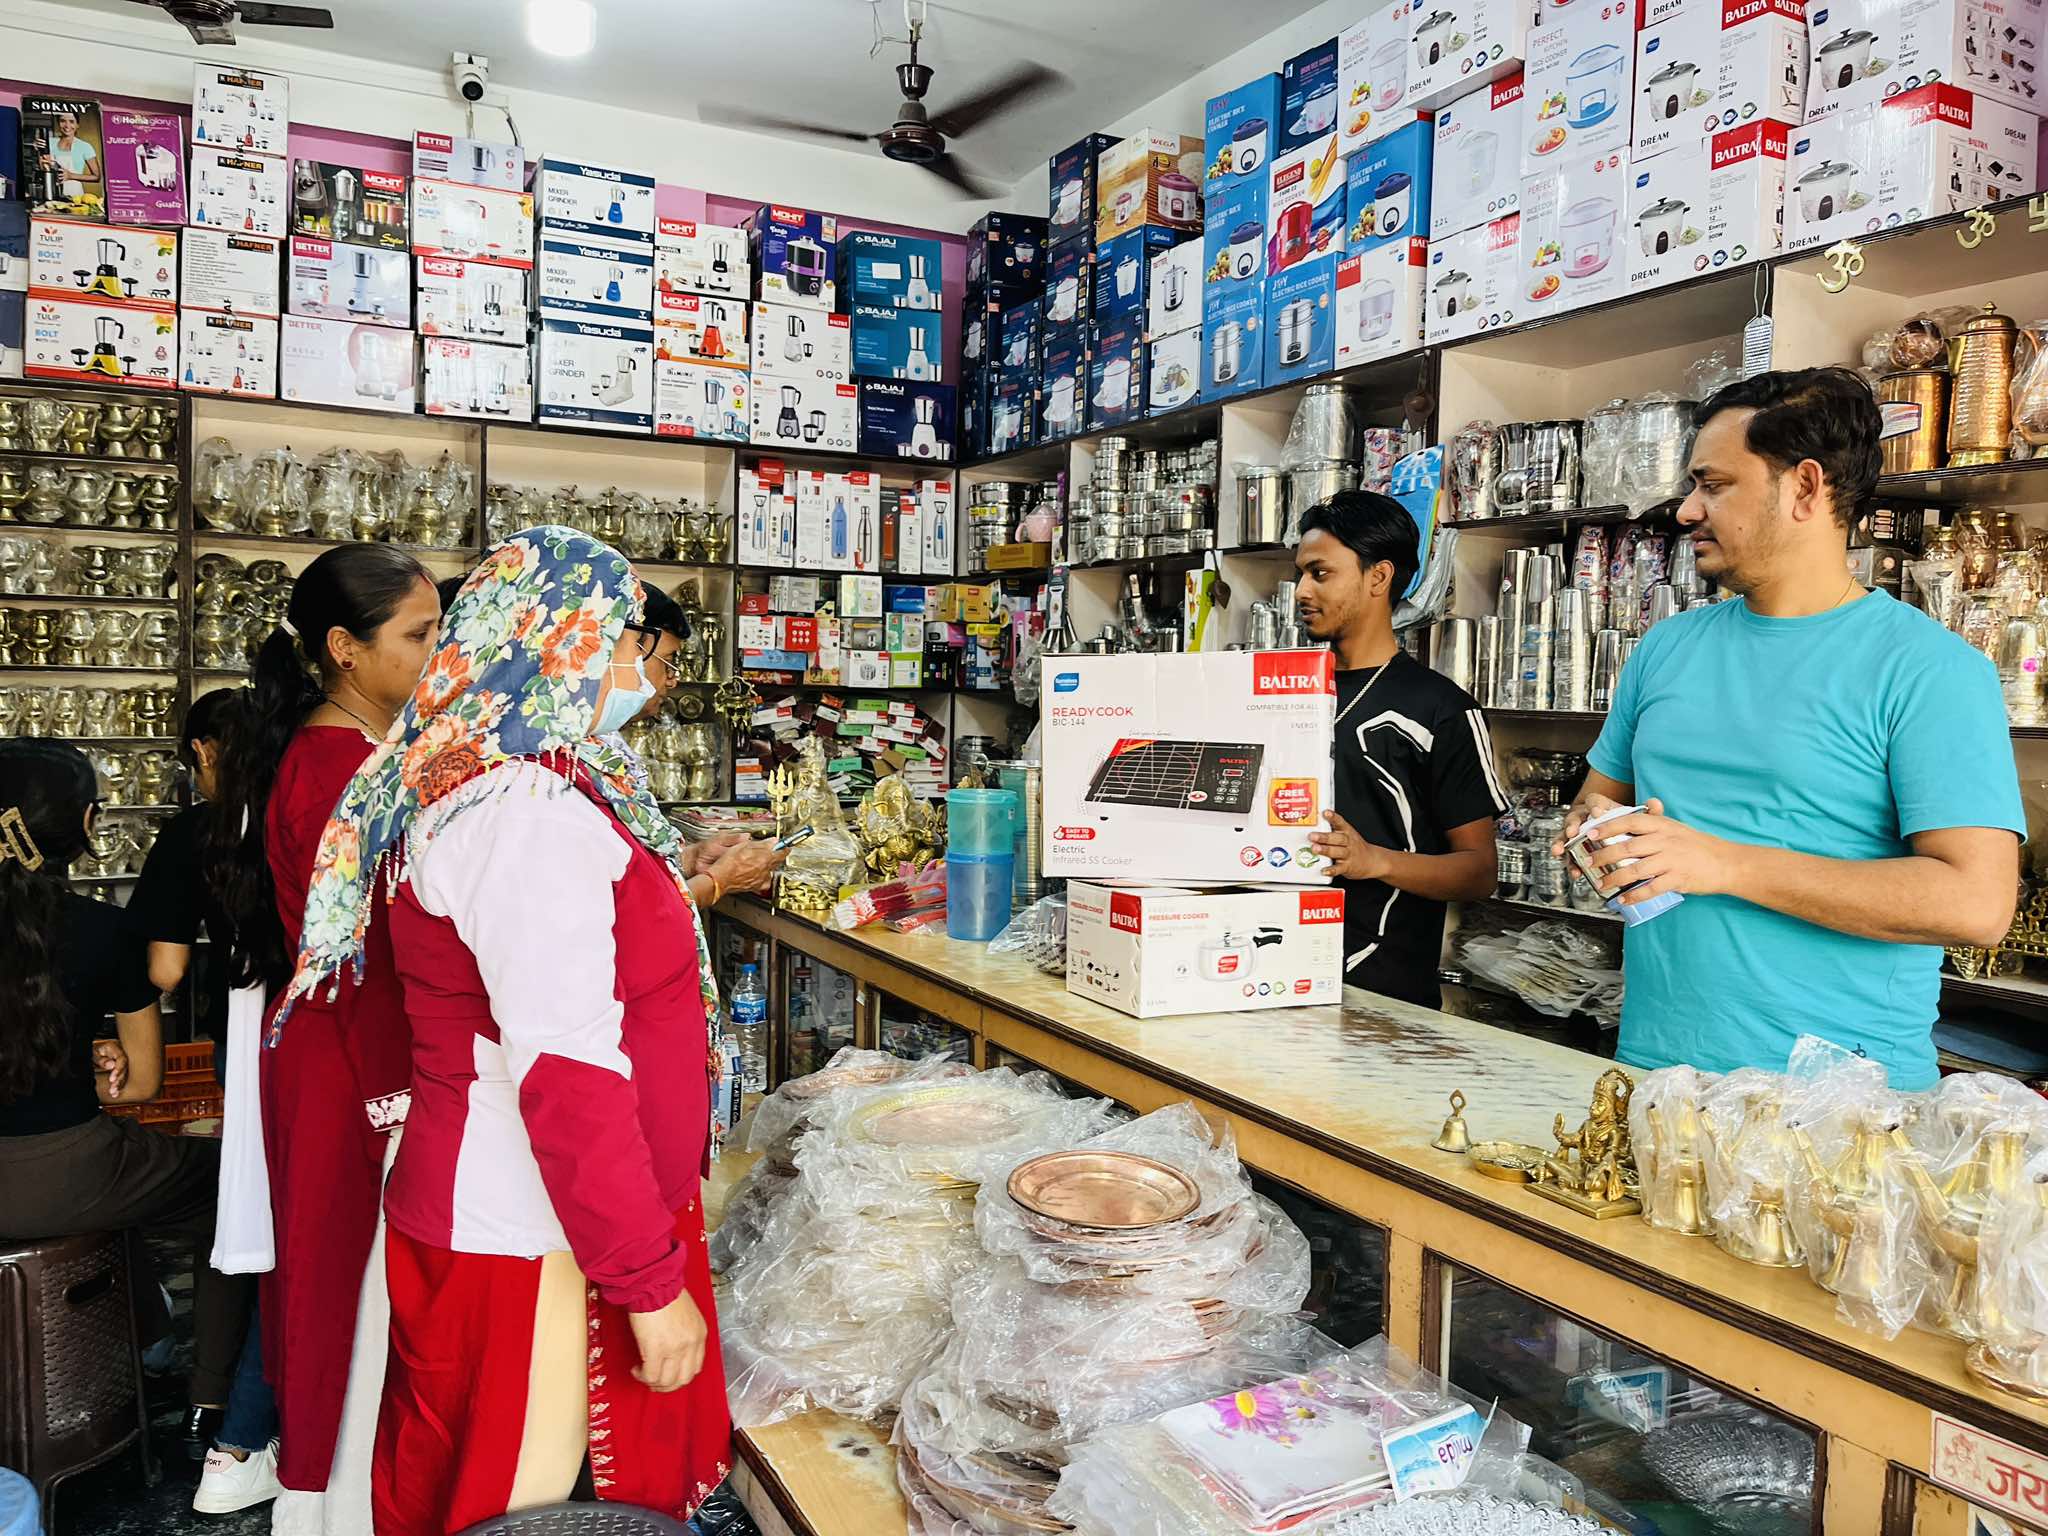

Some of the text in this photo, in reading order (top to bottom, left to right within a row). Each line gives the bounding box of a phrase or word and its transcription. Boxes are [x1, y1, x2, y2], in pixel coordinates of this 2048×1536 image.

[1653, 0, 1682, 16] DREAM
[1725, 0, 1768, 23] BALTRA
[1775, 0, 1806, 15] BALTRA
[1533, 28, 1564, 48] PERFECT
[1899, 50, 1919, 59] Energy
[1409, 77, 1432, 93] DREAM
[1719, 81, 1737, 91] Energy
[32, 101, 88, 114] SOKANY
[1809, 102, 1839, 118] DREAM
[1939, 103, 1970, 123] BALTRA
[1438, 122, 1461, 139] CLOUD
[2004, 127, 2027, 141] DREAM
[107, 136, 137, 145] JUICER
[419, 135, 451, 148] BETTER
[1151, 138, 1176, 149] WEGA
[1640, 131, 1669, 147] DREAM
[1715, 140, 1758, 163] BALTRA
[364, 174, 402, 187] MOHIT
[579, 166, 622, 182] Yasuda
[1879, 186, 1899, 194] Energy
[772, 209, 804, 222] MOHIT
[660, 224, 695, 235] MOHIT
[1709, 222, 1727, 231] Energy
[40, 234, 63, 243] TULIP
[864, 236, 896, 246] BAJAJ
[1789, 235, 1820, 249] DREAM
[236, 240, 274, 252] HAFNER
[295, 242, 330, 255] BETTER
[38, 250, 62, 259] BOLT
[577, 246, 620, 261] Yasuda
[1338, 259, 1360, 272] BALTRA
[1632, 267, 1660, 282] DREAM
[1272, 275, 1288, 291] JOY
[1272, 273, 1330, 300] ELECTRIC RICE COOKER
[663, 295, 697, 308] MOHIT
[37, 312, 61, 321] TULIP
[864, 307, 897, 317] BAJAJ
[35, 330, 58, 338] BOLT
[577, 323, 622, 338] Yasuda
[1430, 328, 1450, 339] DREAM
[873, 383, 905, 392] BAJAJ
[1260, 676, 1320, 689] BALTRA
[1052, 718, 1086, 726] BIC-144
[1278, 789, 1304, 798] FREE
[1052, 844, 1086, 853] Electric
[1052, 856, 1133, 865] Infrared SS Cooker
[1111, 912, 1139, 929] BALTRA
[1149, 912, 1209, 921] PRESSURE COOKER
[1303, 908, 1341, 920] BALTRA
